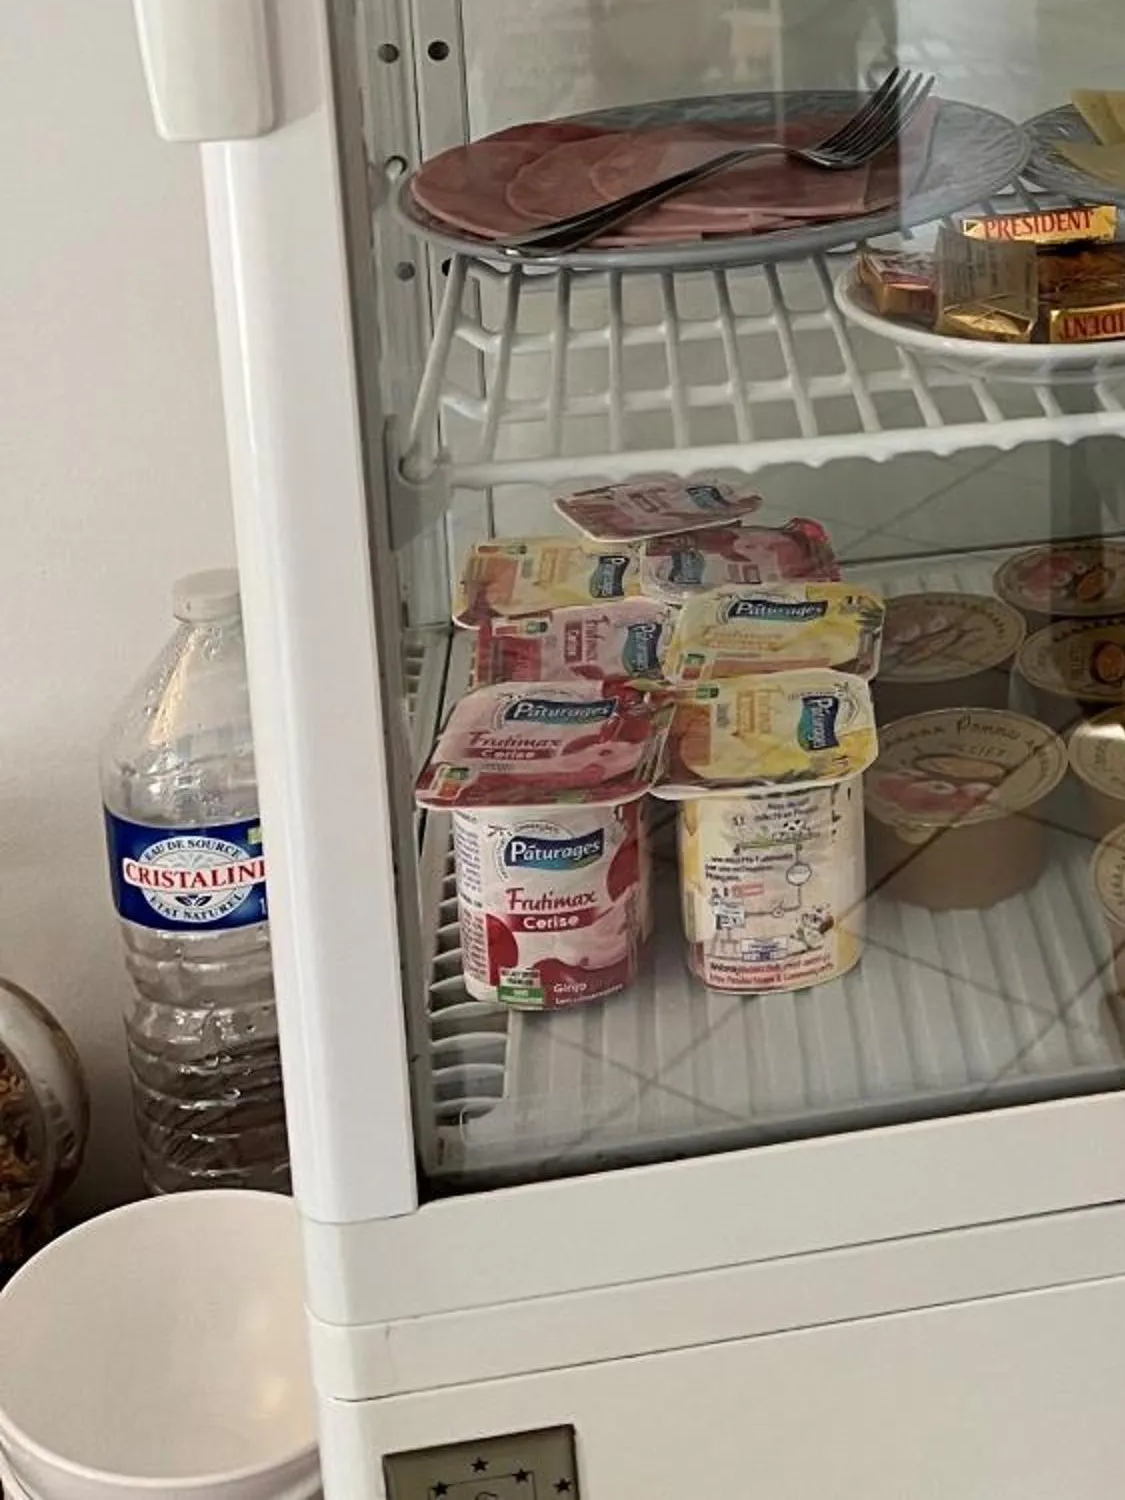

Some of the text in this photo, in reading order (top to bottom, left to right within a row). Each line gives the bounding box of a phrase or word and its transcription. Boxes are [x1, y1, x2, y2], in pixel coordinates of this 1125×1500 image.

[983, 210, 1094, 241] PRESIDENT
[187, 838, 242, 858] SOURCE
[510, 840, 600, 863] Pâturages
[504, 886, 598, 912] Frutimax
[522, 914, 580, 930] Cerise
